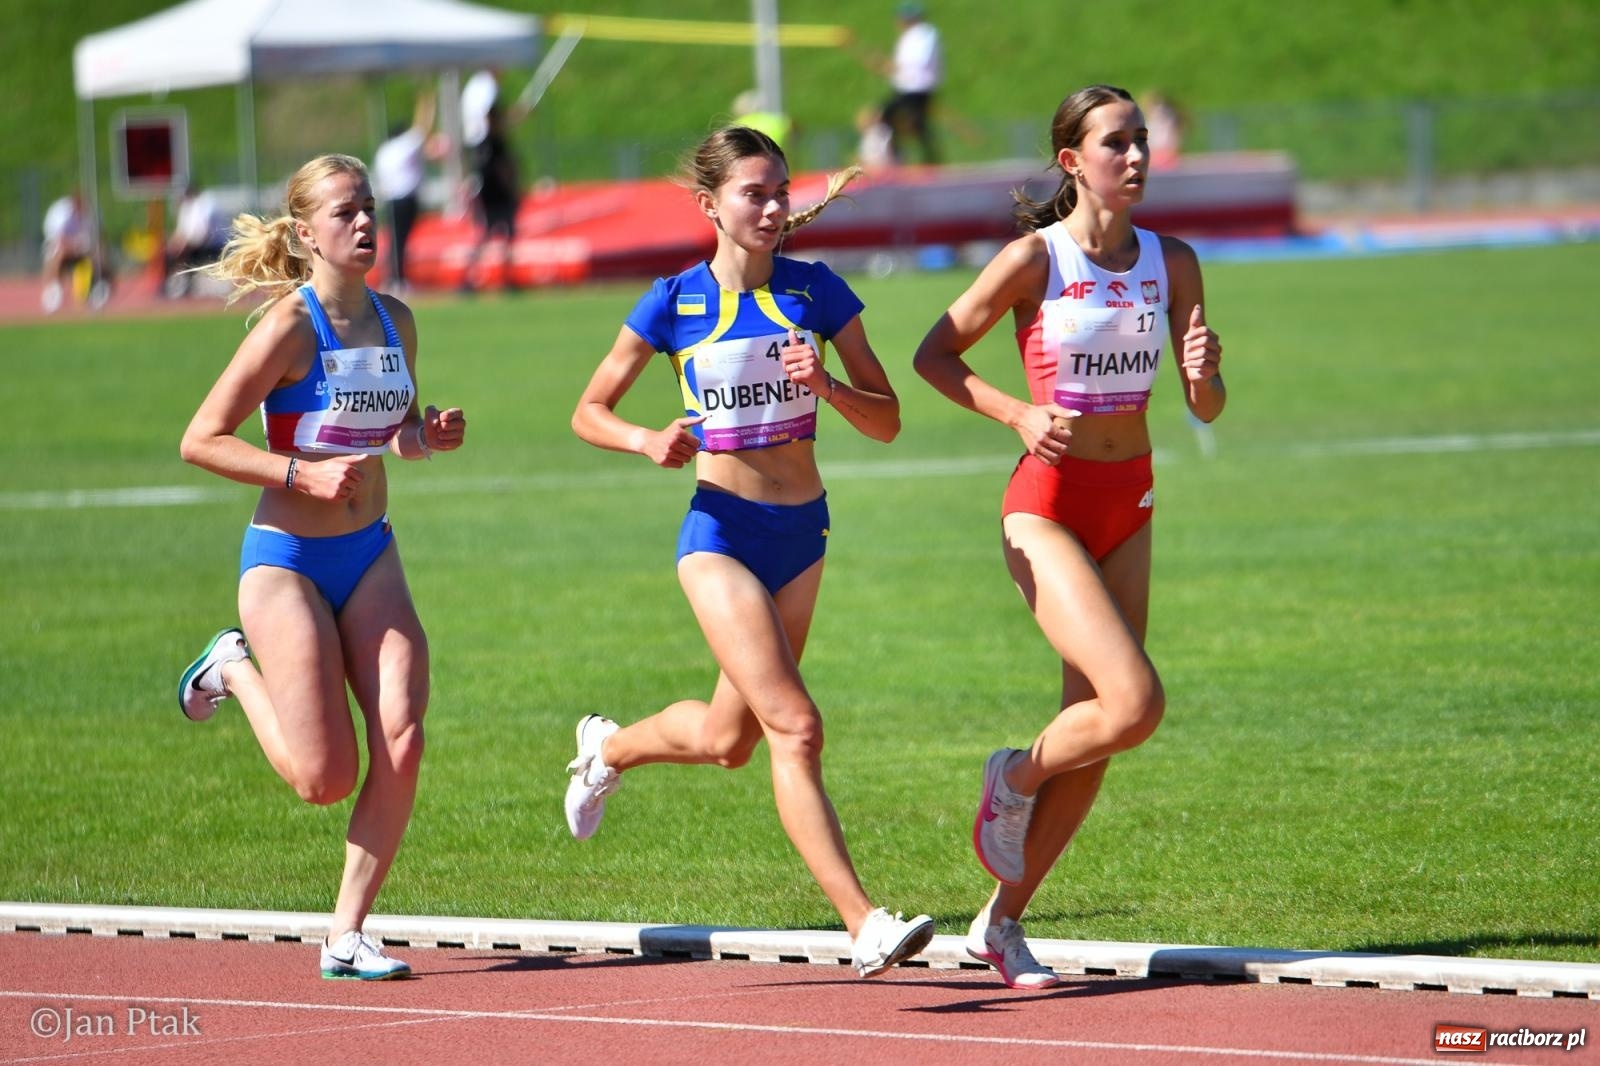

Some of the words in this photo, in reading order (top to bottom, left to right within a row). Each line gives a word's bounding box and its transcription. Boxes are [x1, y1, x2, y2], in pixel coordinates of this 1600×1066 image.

[1105, 300, 1134, 308] ORLEN
[1137, 311, 1155, 333] 17
[380, 353, 400, 372] 117
[1070, 349, 1160, 376] THAMM
[332, 385, 410, 412] ŠTEFANOVÁ
